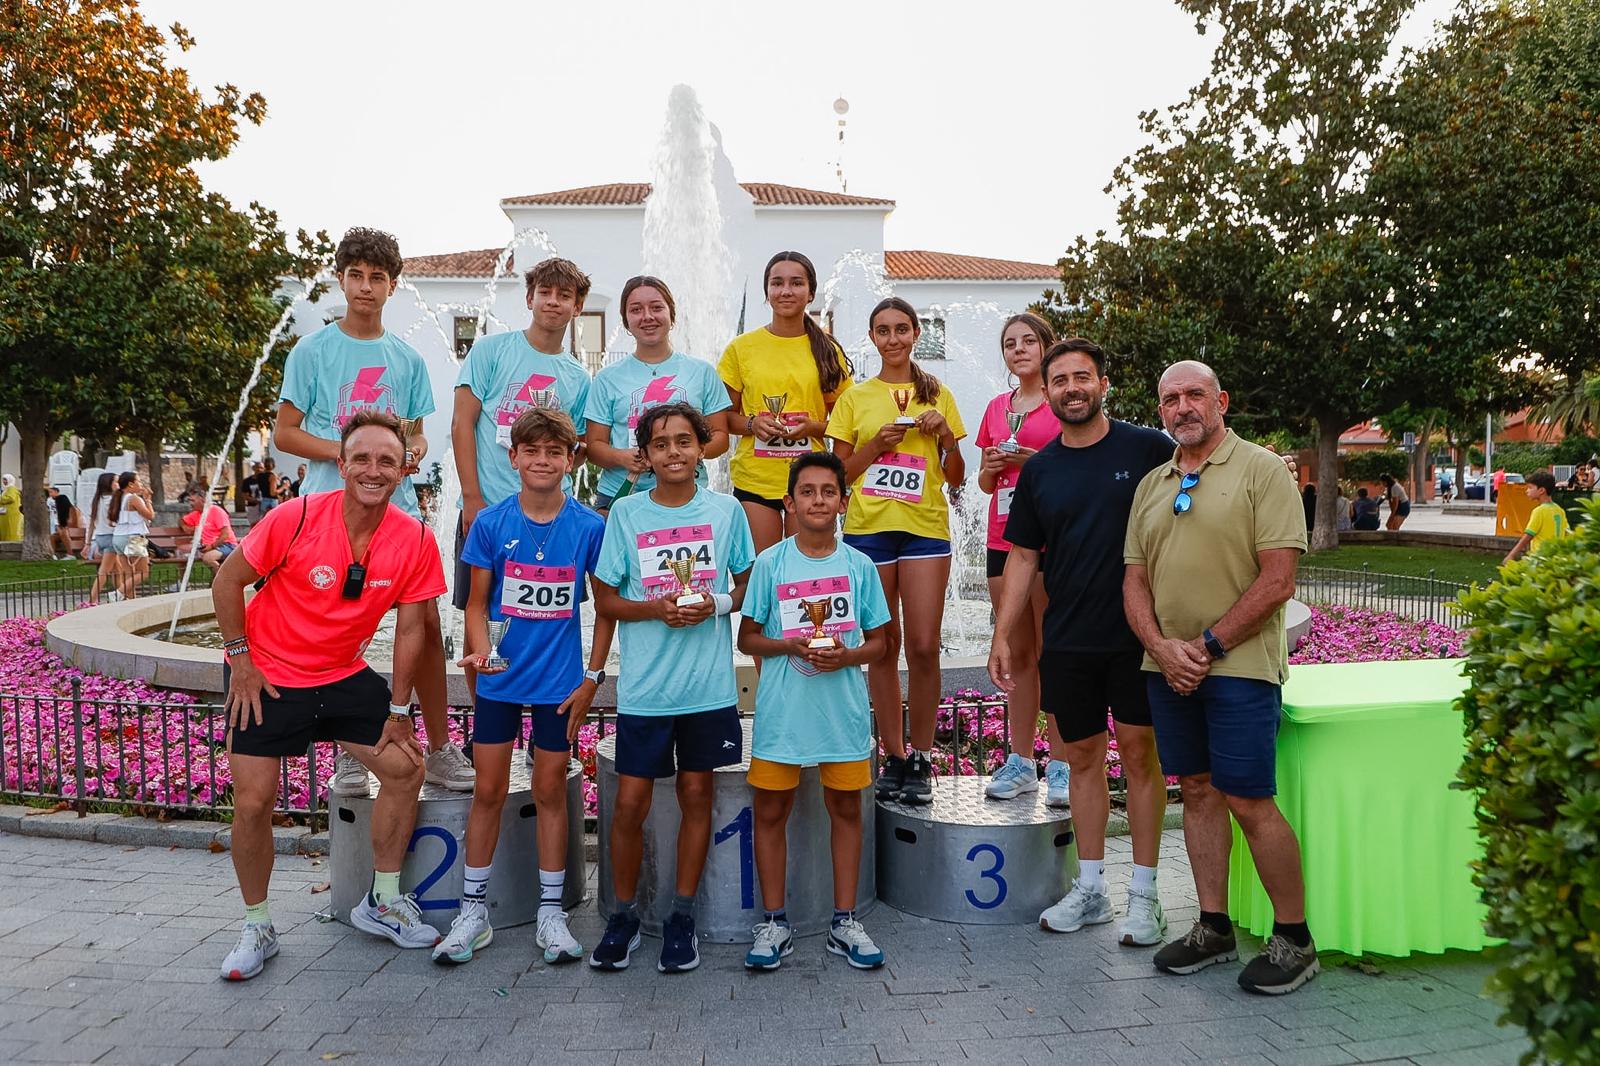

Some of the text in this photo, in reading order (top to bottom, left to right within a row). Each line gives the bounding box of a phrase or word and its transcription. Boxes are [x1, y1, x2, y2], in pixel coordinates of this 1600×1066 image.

[875, 468, 920, 490] 208
[656, 544, 711, 571] 204
[517, 583, 570, 607] 205
[797, 597, 849, 623] 29
[407, 826, 460, 910] 2
[714, 806, 754, 910] 1
[964, 843, 1008, 909] 3
